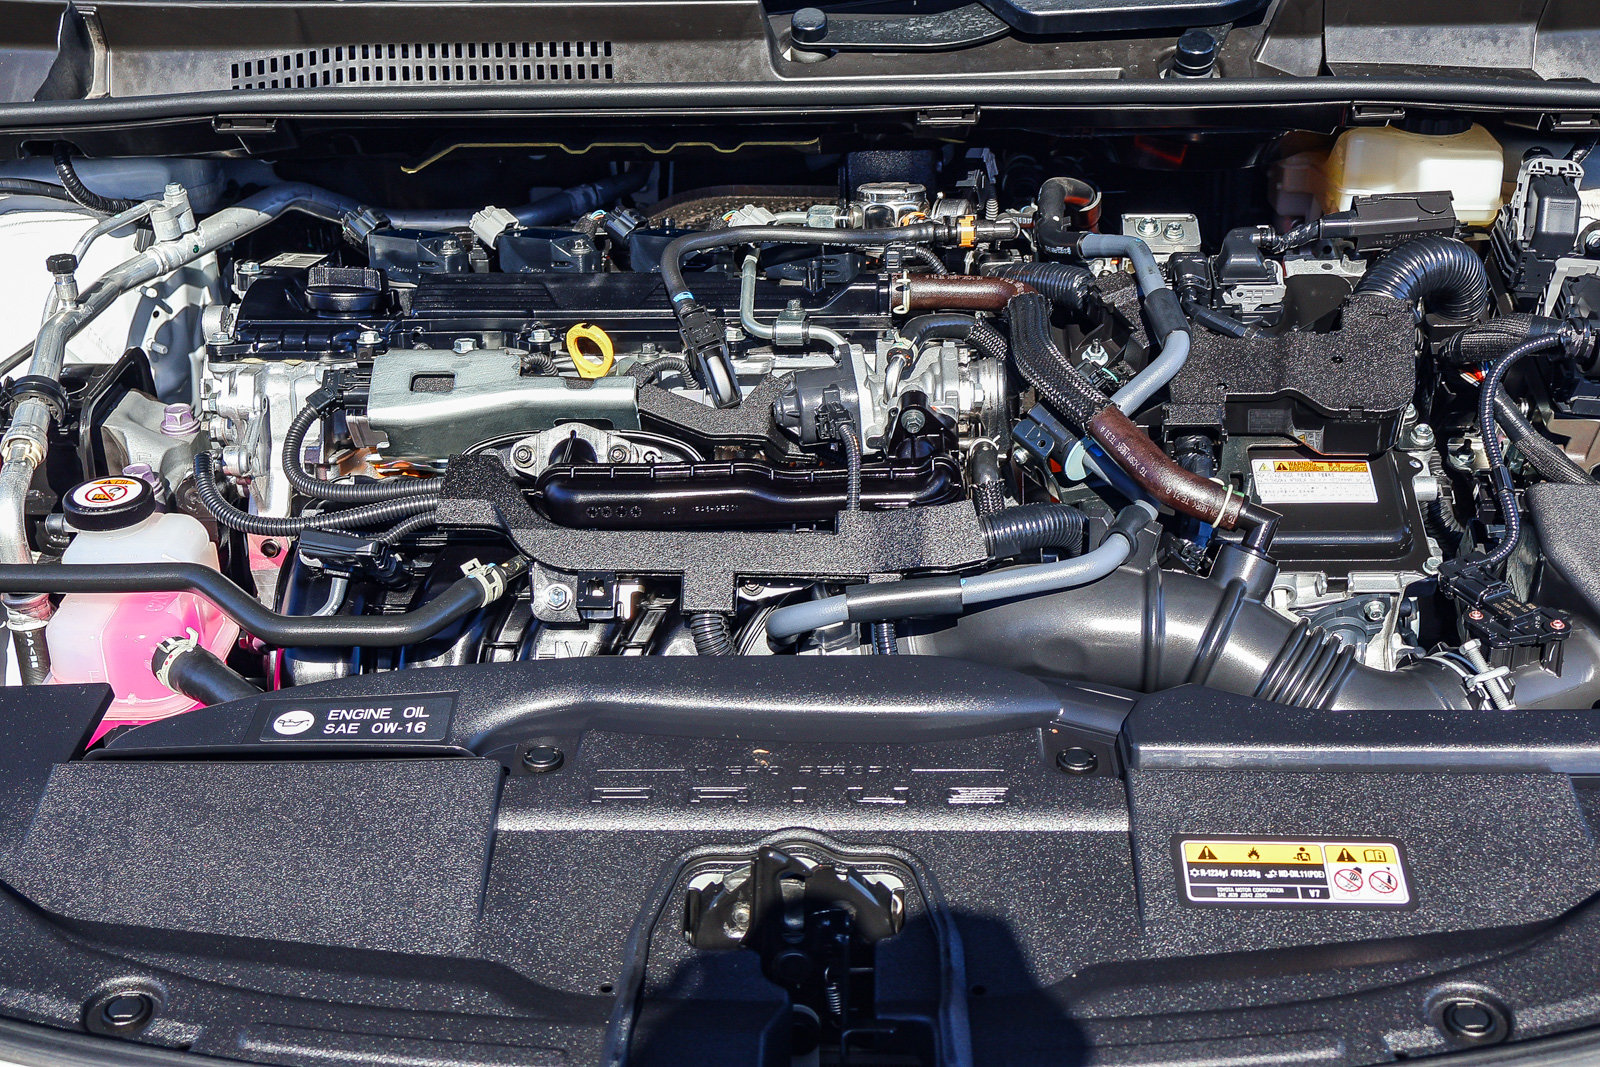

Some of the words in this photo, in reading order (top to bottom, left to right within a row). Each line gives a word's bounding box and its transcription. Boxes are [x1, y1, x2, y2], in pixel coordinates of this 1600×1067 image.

[327, 708, 392, 720] ENGINE
[403, 706, 430, 718] OIL
[323, 723, 360, 734] SAE
[371, 722, 427, 734] 0W-16
[591, 785, 1010, 805] PRIUS
[1308, 889, 1321, 898] V7
